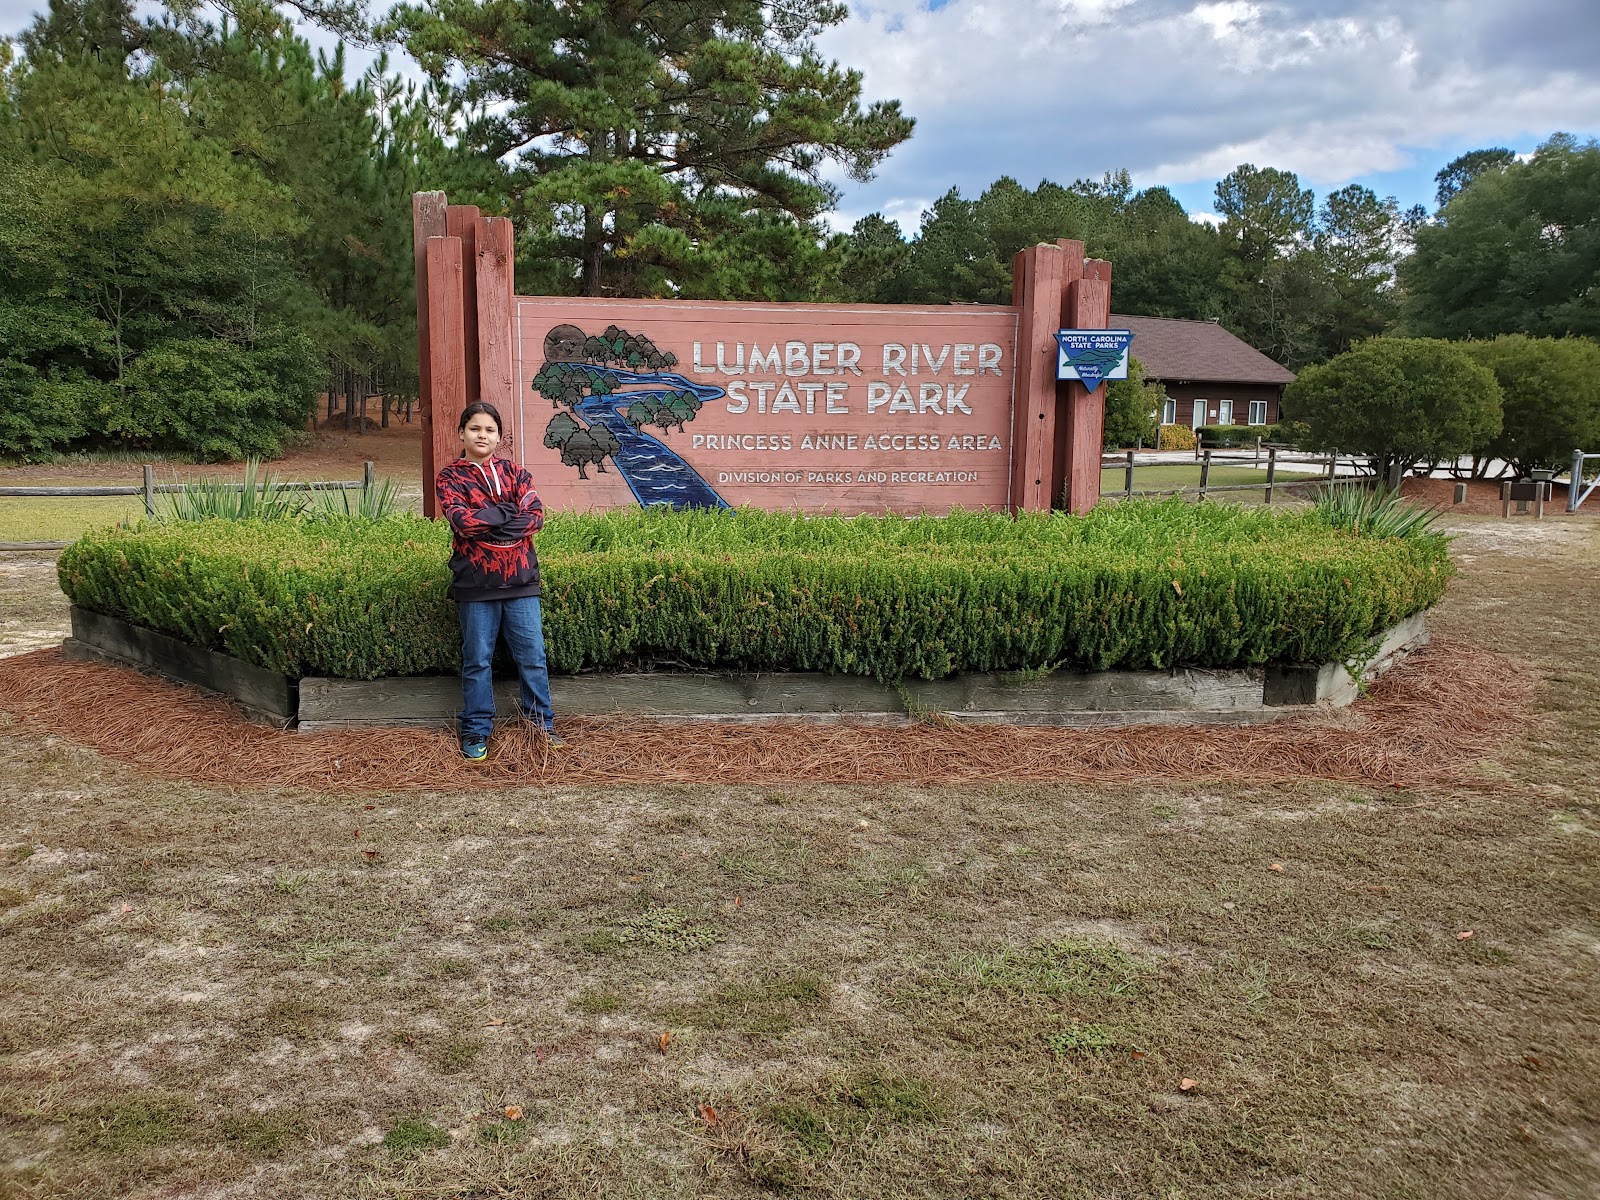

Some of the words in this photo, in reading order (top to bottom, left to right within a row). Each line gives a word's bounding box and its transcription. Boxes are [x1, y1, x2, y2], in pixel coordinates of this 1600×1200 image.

[693, 341, 863, 377] LUMBER
[882, 343, 1004, 377] RIVER
[726, 380, 849, 414] STATE
[867, 381, 973, 416] PARK
[692, 434, 793, 451] PRINCESS
[800, 434, 859, 450] ANNE
[863, 434, 940, 451] ACCESS
[947, 434, 1002, 451] AREA
[719, 472, 781, 483] DIVISION
[785, 472, 804, 483] OF
[808, 472, 852, 483] PARKS
[857, 472, 887, 483] AND
[891, 471, 978, 482] RECREATION
